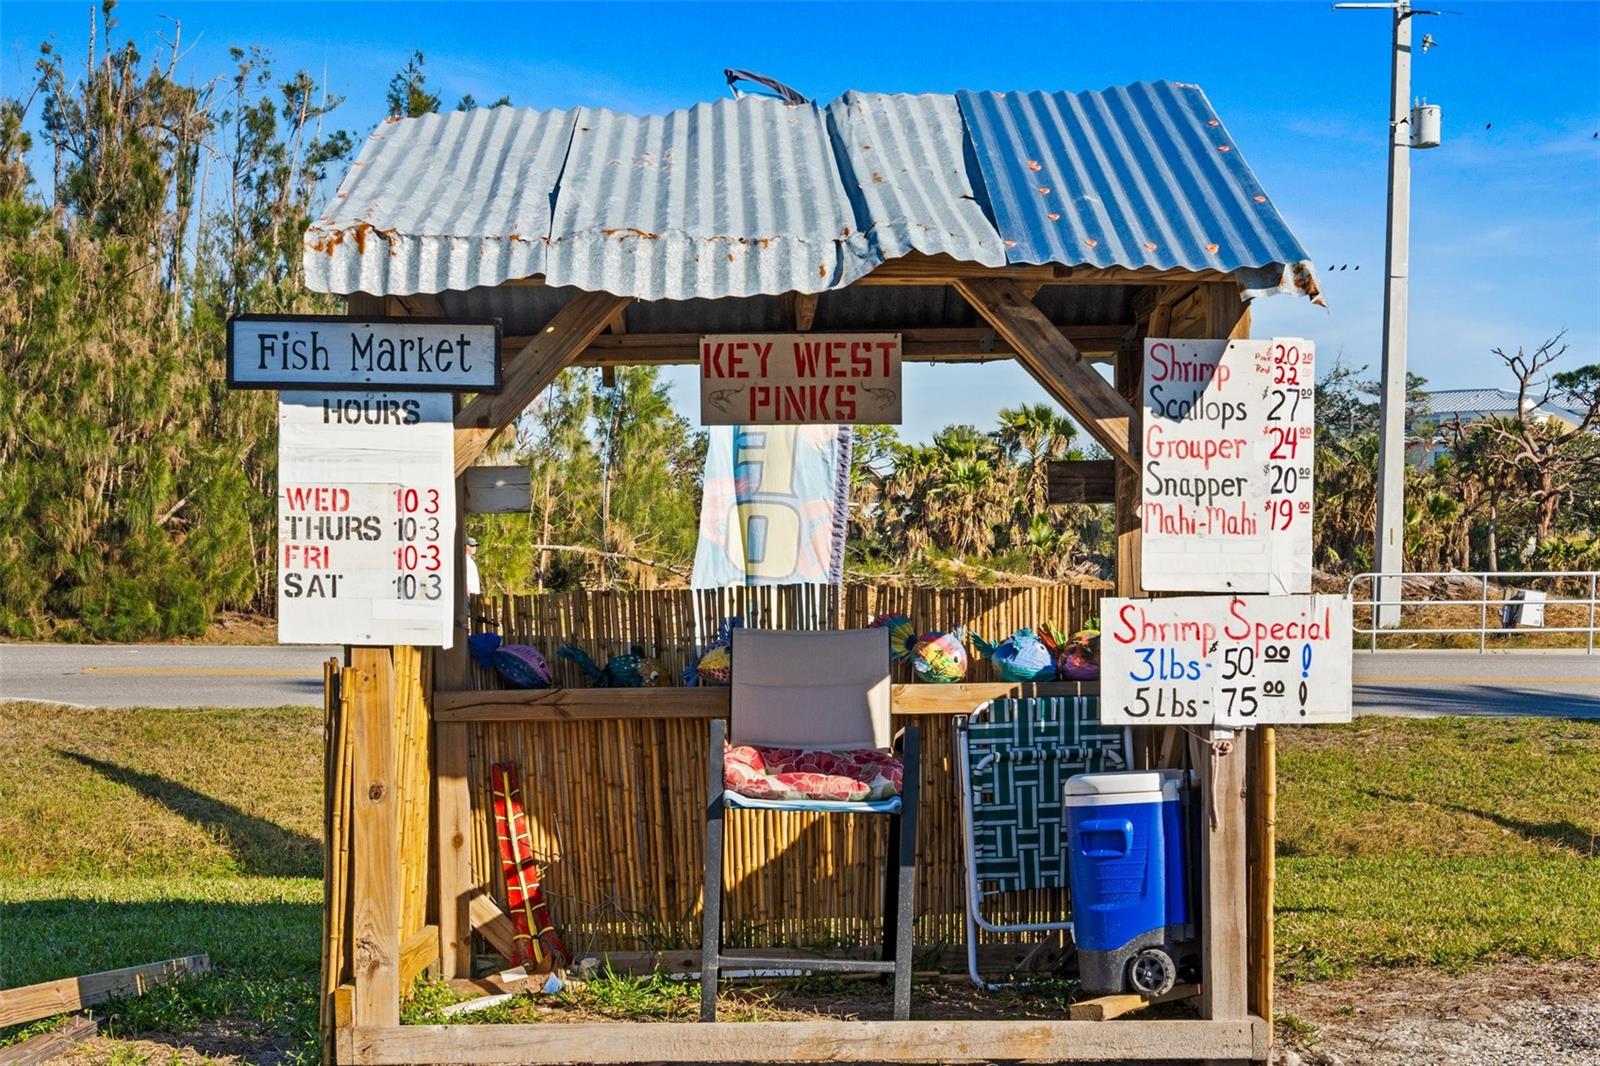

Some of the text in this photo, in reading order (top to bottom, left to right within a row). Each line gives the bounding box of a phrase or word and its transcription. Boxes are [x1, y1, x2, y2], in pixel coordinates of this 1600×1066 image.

[257, 331, 472, 373] Fish Market
[703, 342, 897, 379] KEY WEST
[1150, 342, 1231, 391] Shrimp
[322, 398, 421, 425] HOURS
[749, 385, 857, 421] PINKS
[1149, 384, 1248, 429] Scallops
[1146, 424, 1248, 469] Grouper
[285, 487, 351, 512] WED
[1145, 461, 1249, 506] Snapper
[285, 516, 440, 542] THURS 10-3
[1143, 501, 1257, 536] Mahi-Mahi
[284, 544, 442, 571] FRI 10-3
[283, 573, 442, 600] SAT 10-3
[1113, 599, 1331, 658] Shrimp Special
